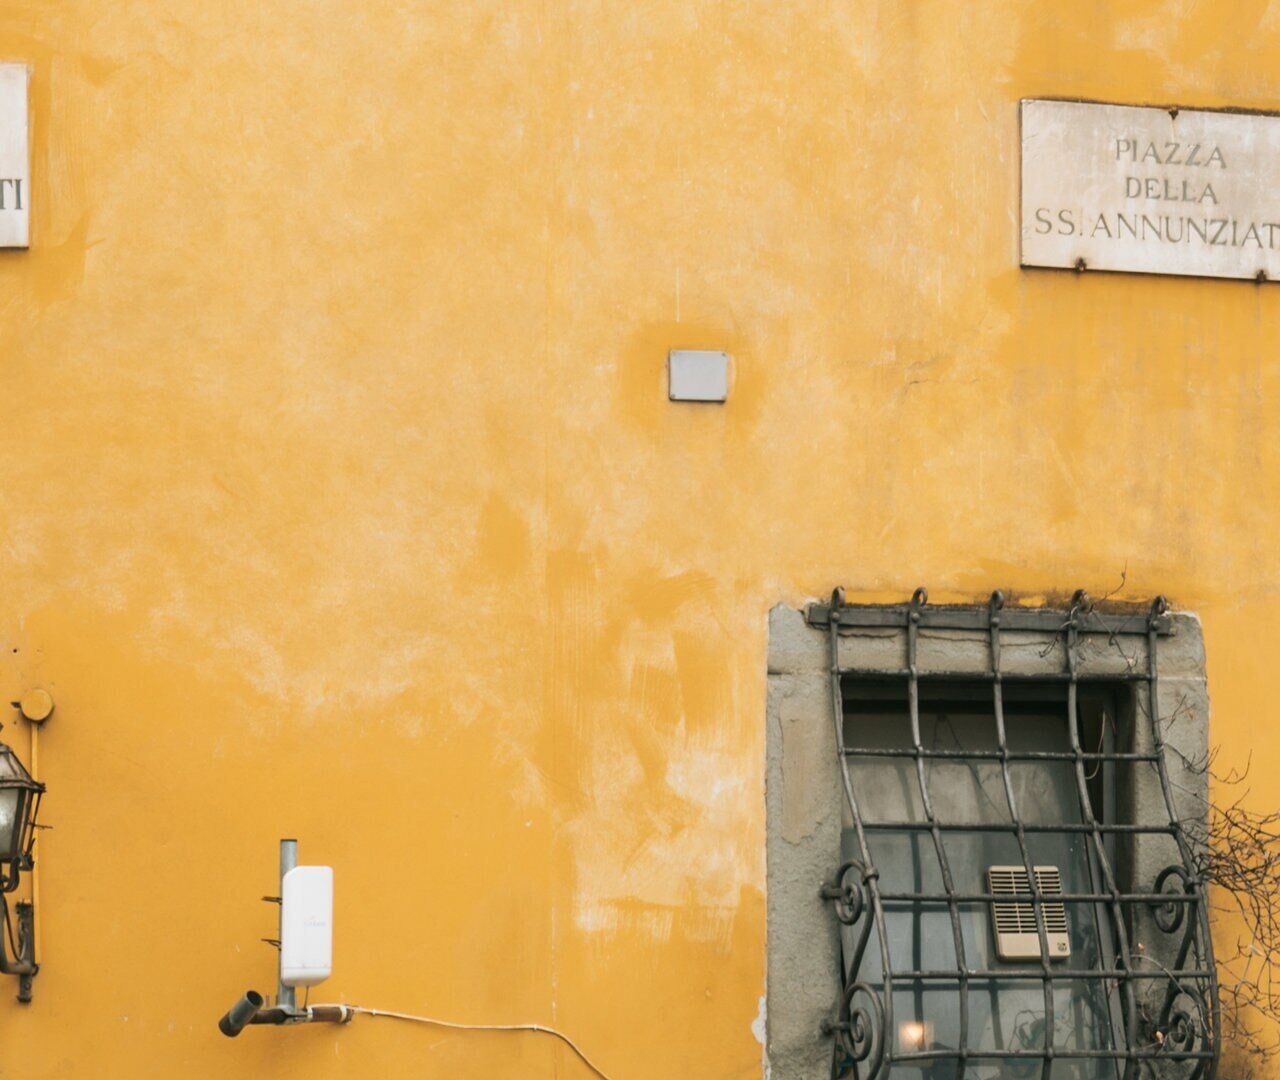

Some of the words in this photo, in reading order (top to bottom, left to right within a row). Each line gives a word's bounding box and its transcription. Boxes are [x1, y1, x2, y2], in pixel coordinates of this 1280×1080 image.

[1115, 138, 1227, 168] PIAZZA
[1125, 177, 1219, 204] DELLA
[1035, 208, 1083, 236] SS.
